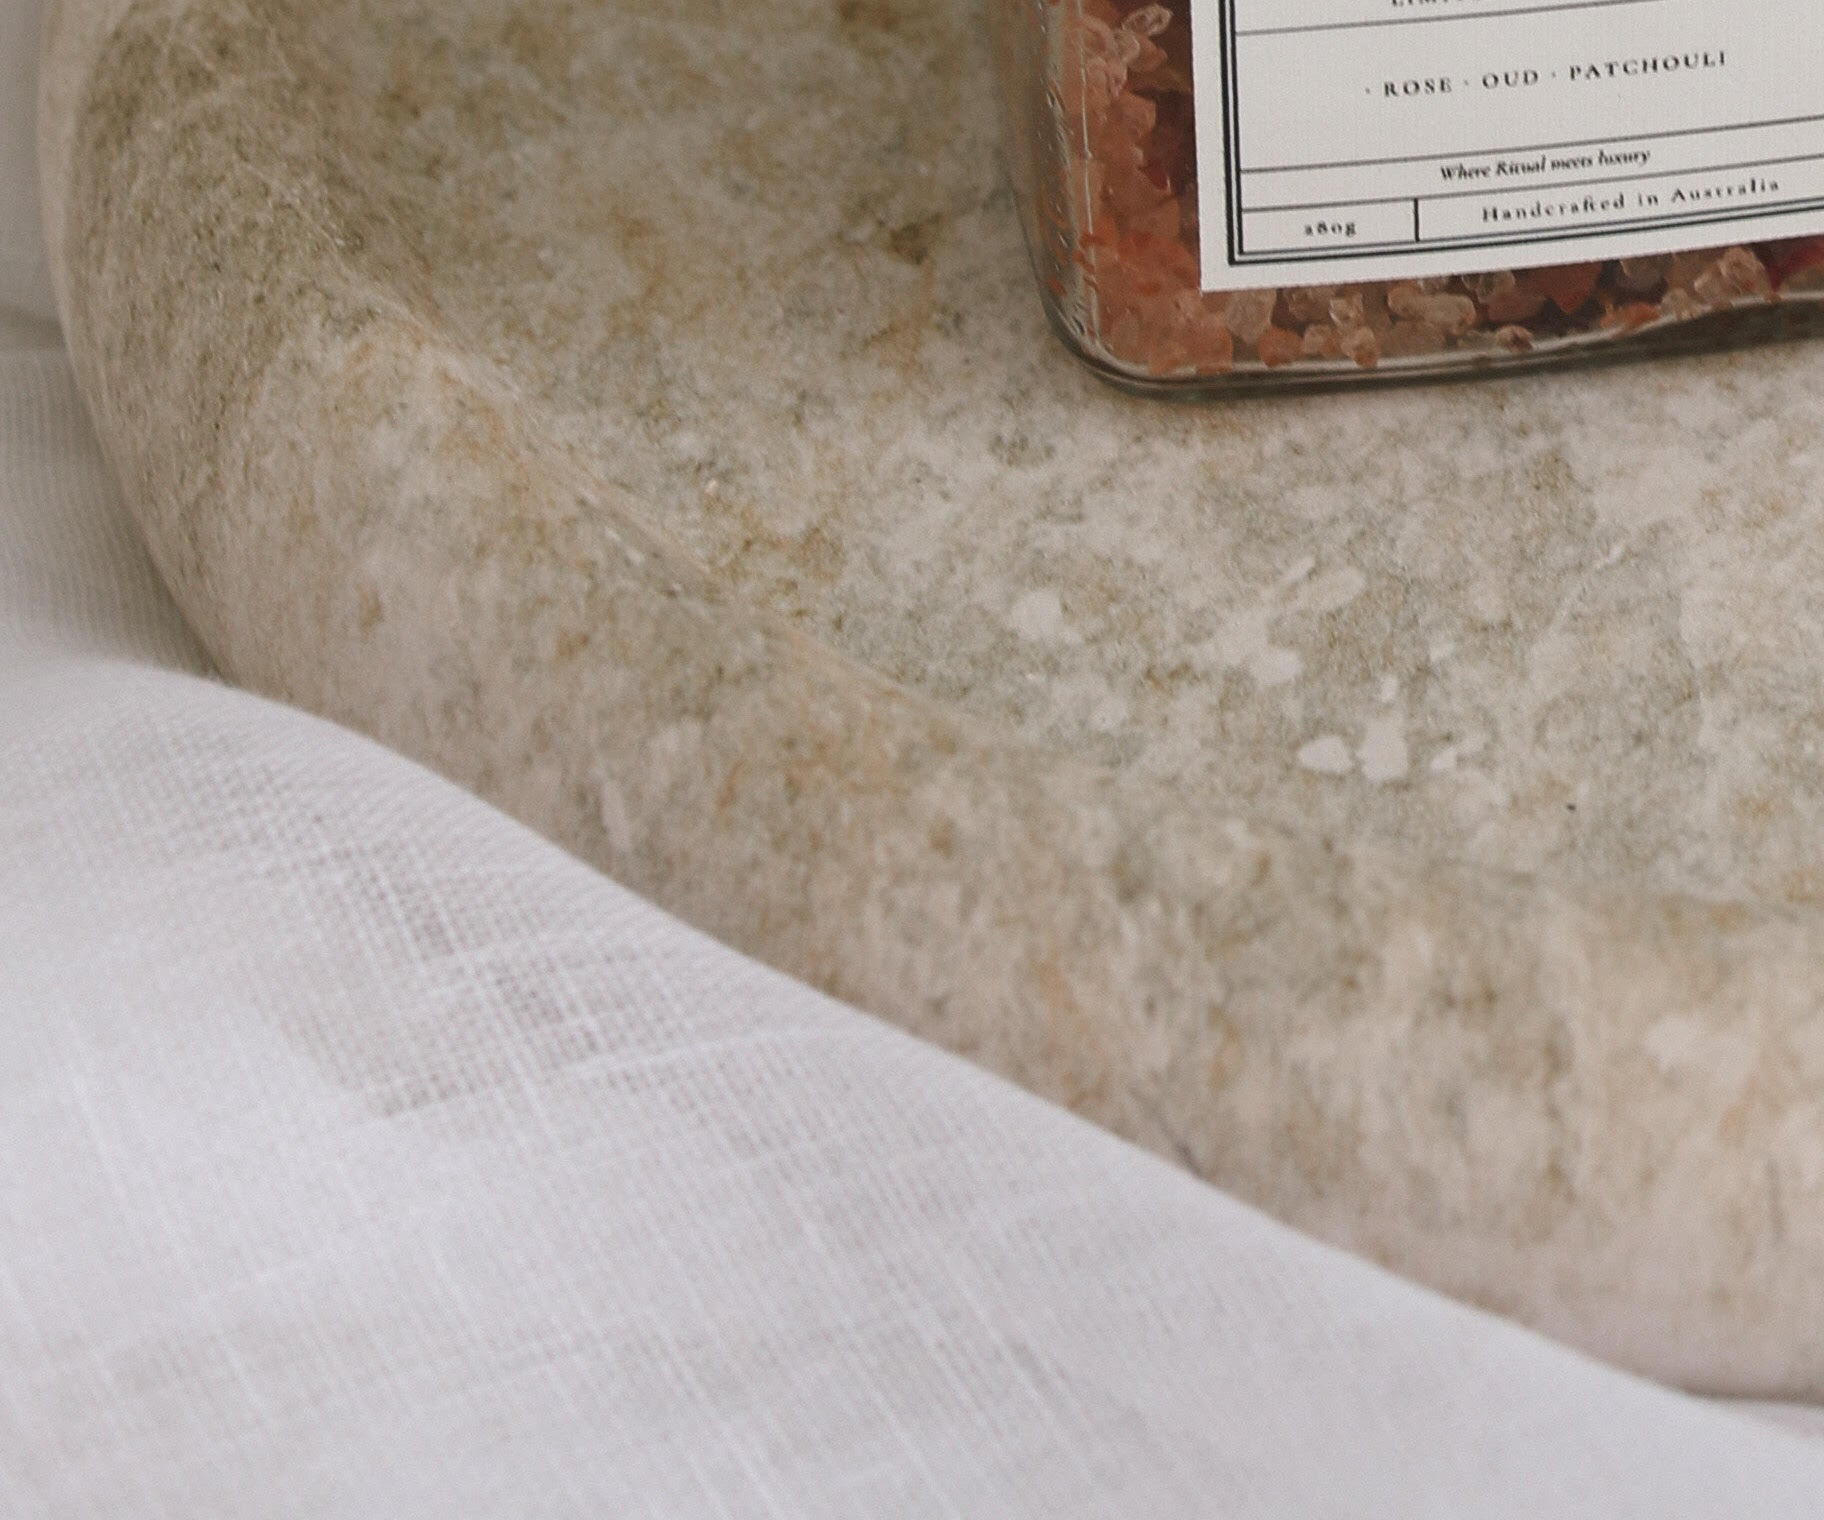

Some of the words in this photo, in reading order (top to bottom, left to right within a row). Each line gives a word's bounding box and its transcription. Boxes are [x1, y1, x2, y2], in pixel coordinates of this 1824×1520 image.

[1383, 76, 1453, 98] ROSE
[1481, 68, 1540, 90] OUD
[1568, 50, 1726, 82] PATCHOULI
[1439, 160, 1491, 182] Where
[1495, 153, 1547, 178] Ritual
[1549, 154, 1594, 172] meets
[1597, 148, 1652, 169] luxury
[1481, 192, 1626, 223] Handcrafted
[1636, 189, 1660, 208] in
[1670, 175, 1781, 206] Australia
